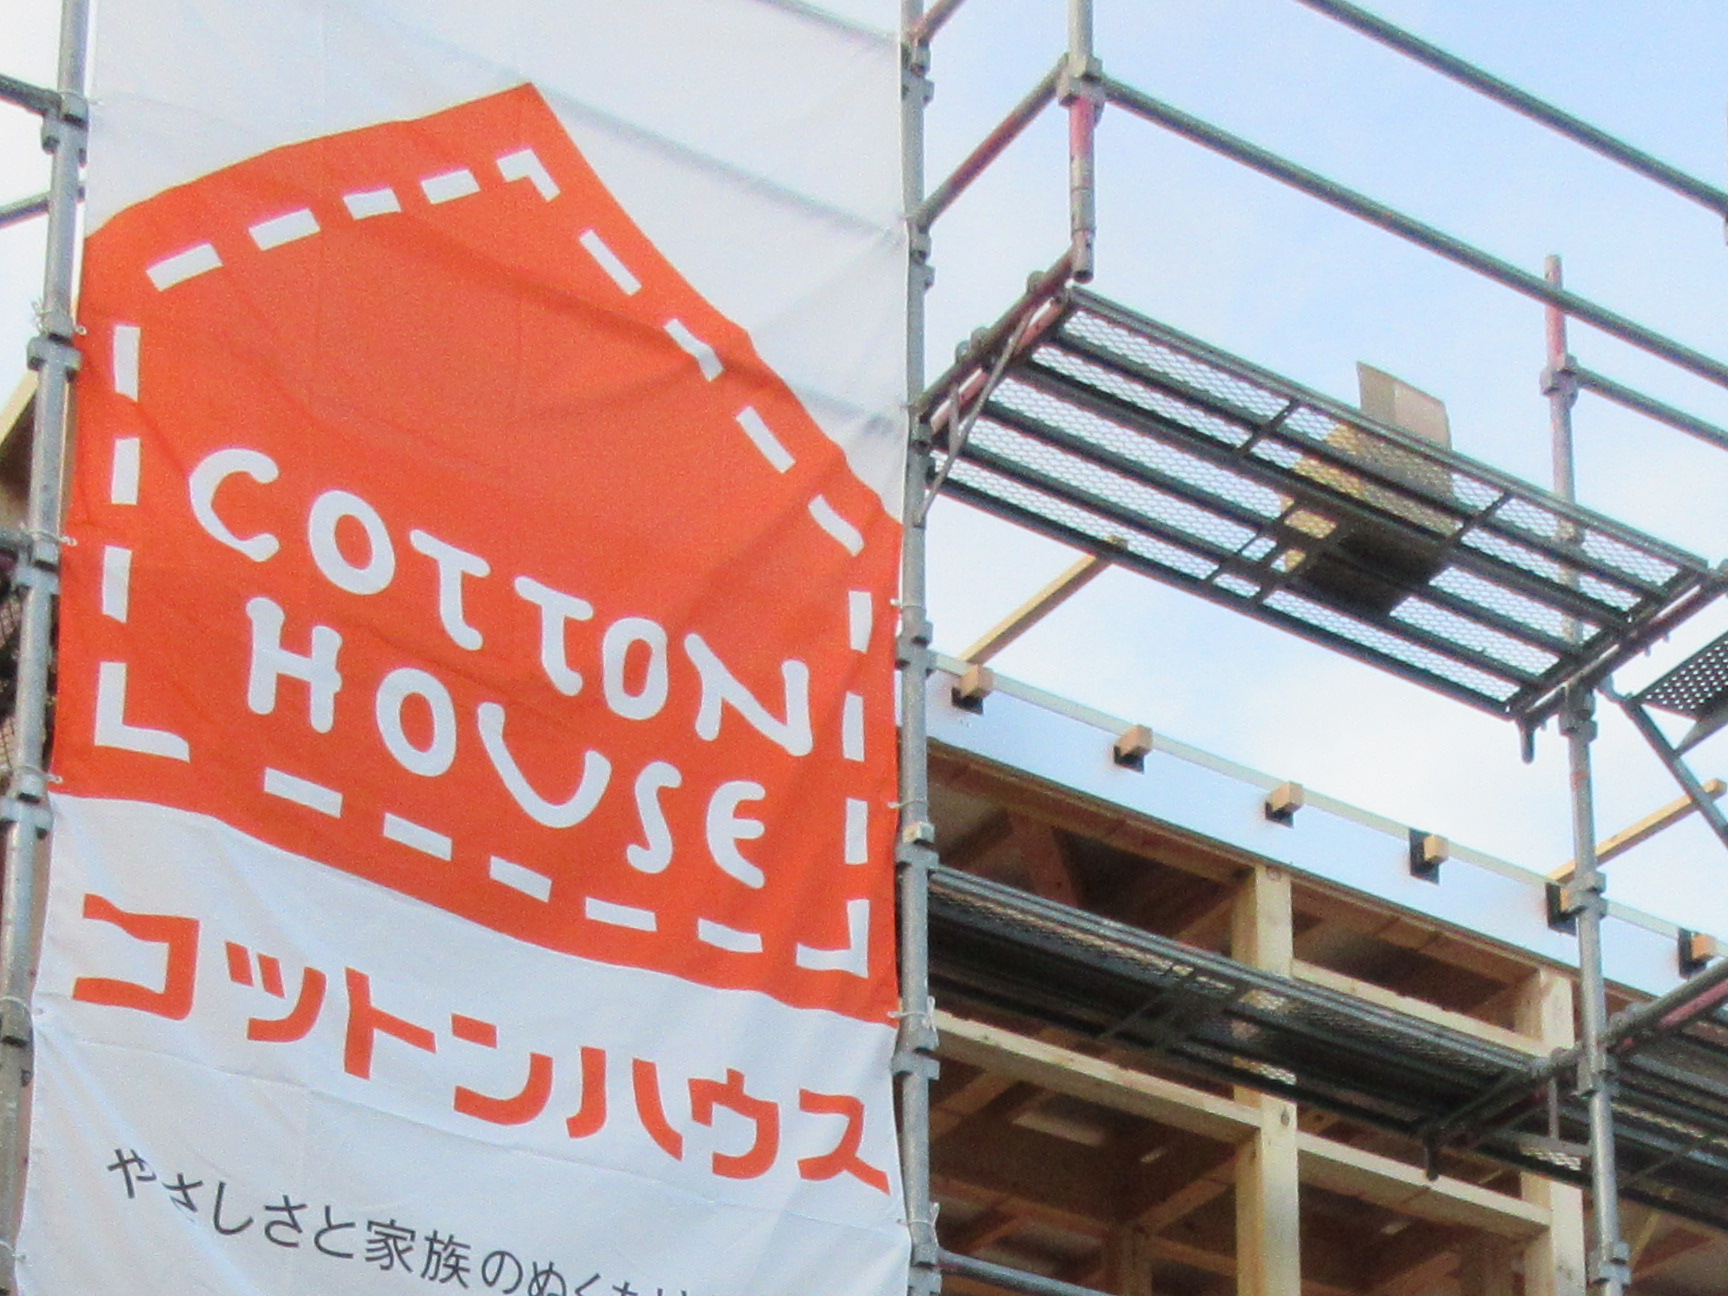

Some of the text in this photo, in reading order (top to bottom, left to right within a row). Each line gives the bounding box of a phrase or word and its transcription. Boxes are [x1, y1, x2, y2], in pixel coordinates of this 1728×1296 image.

[188, 447, 815, 757] COTTON
[245, 597, 767, 888] HOUSE
[72, 892, 891, 1196] コットンハウス
